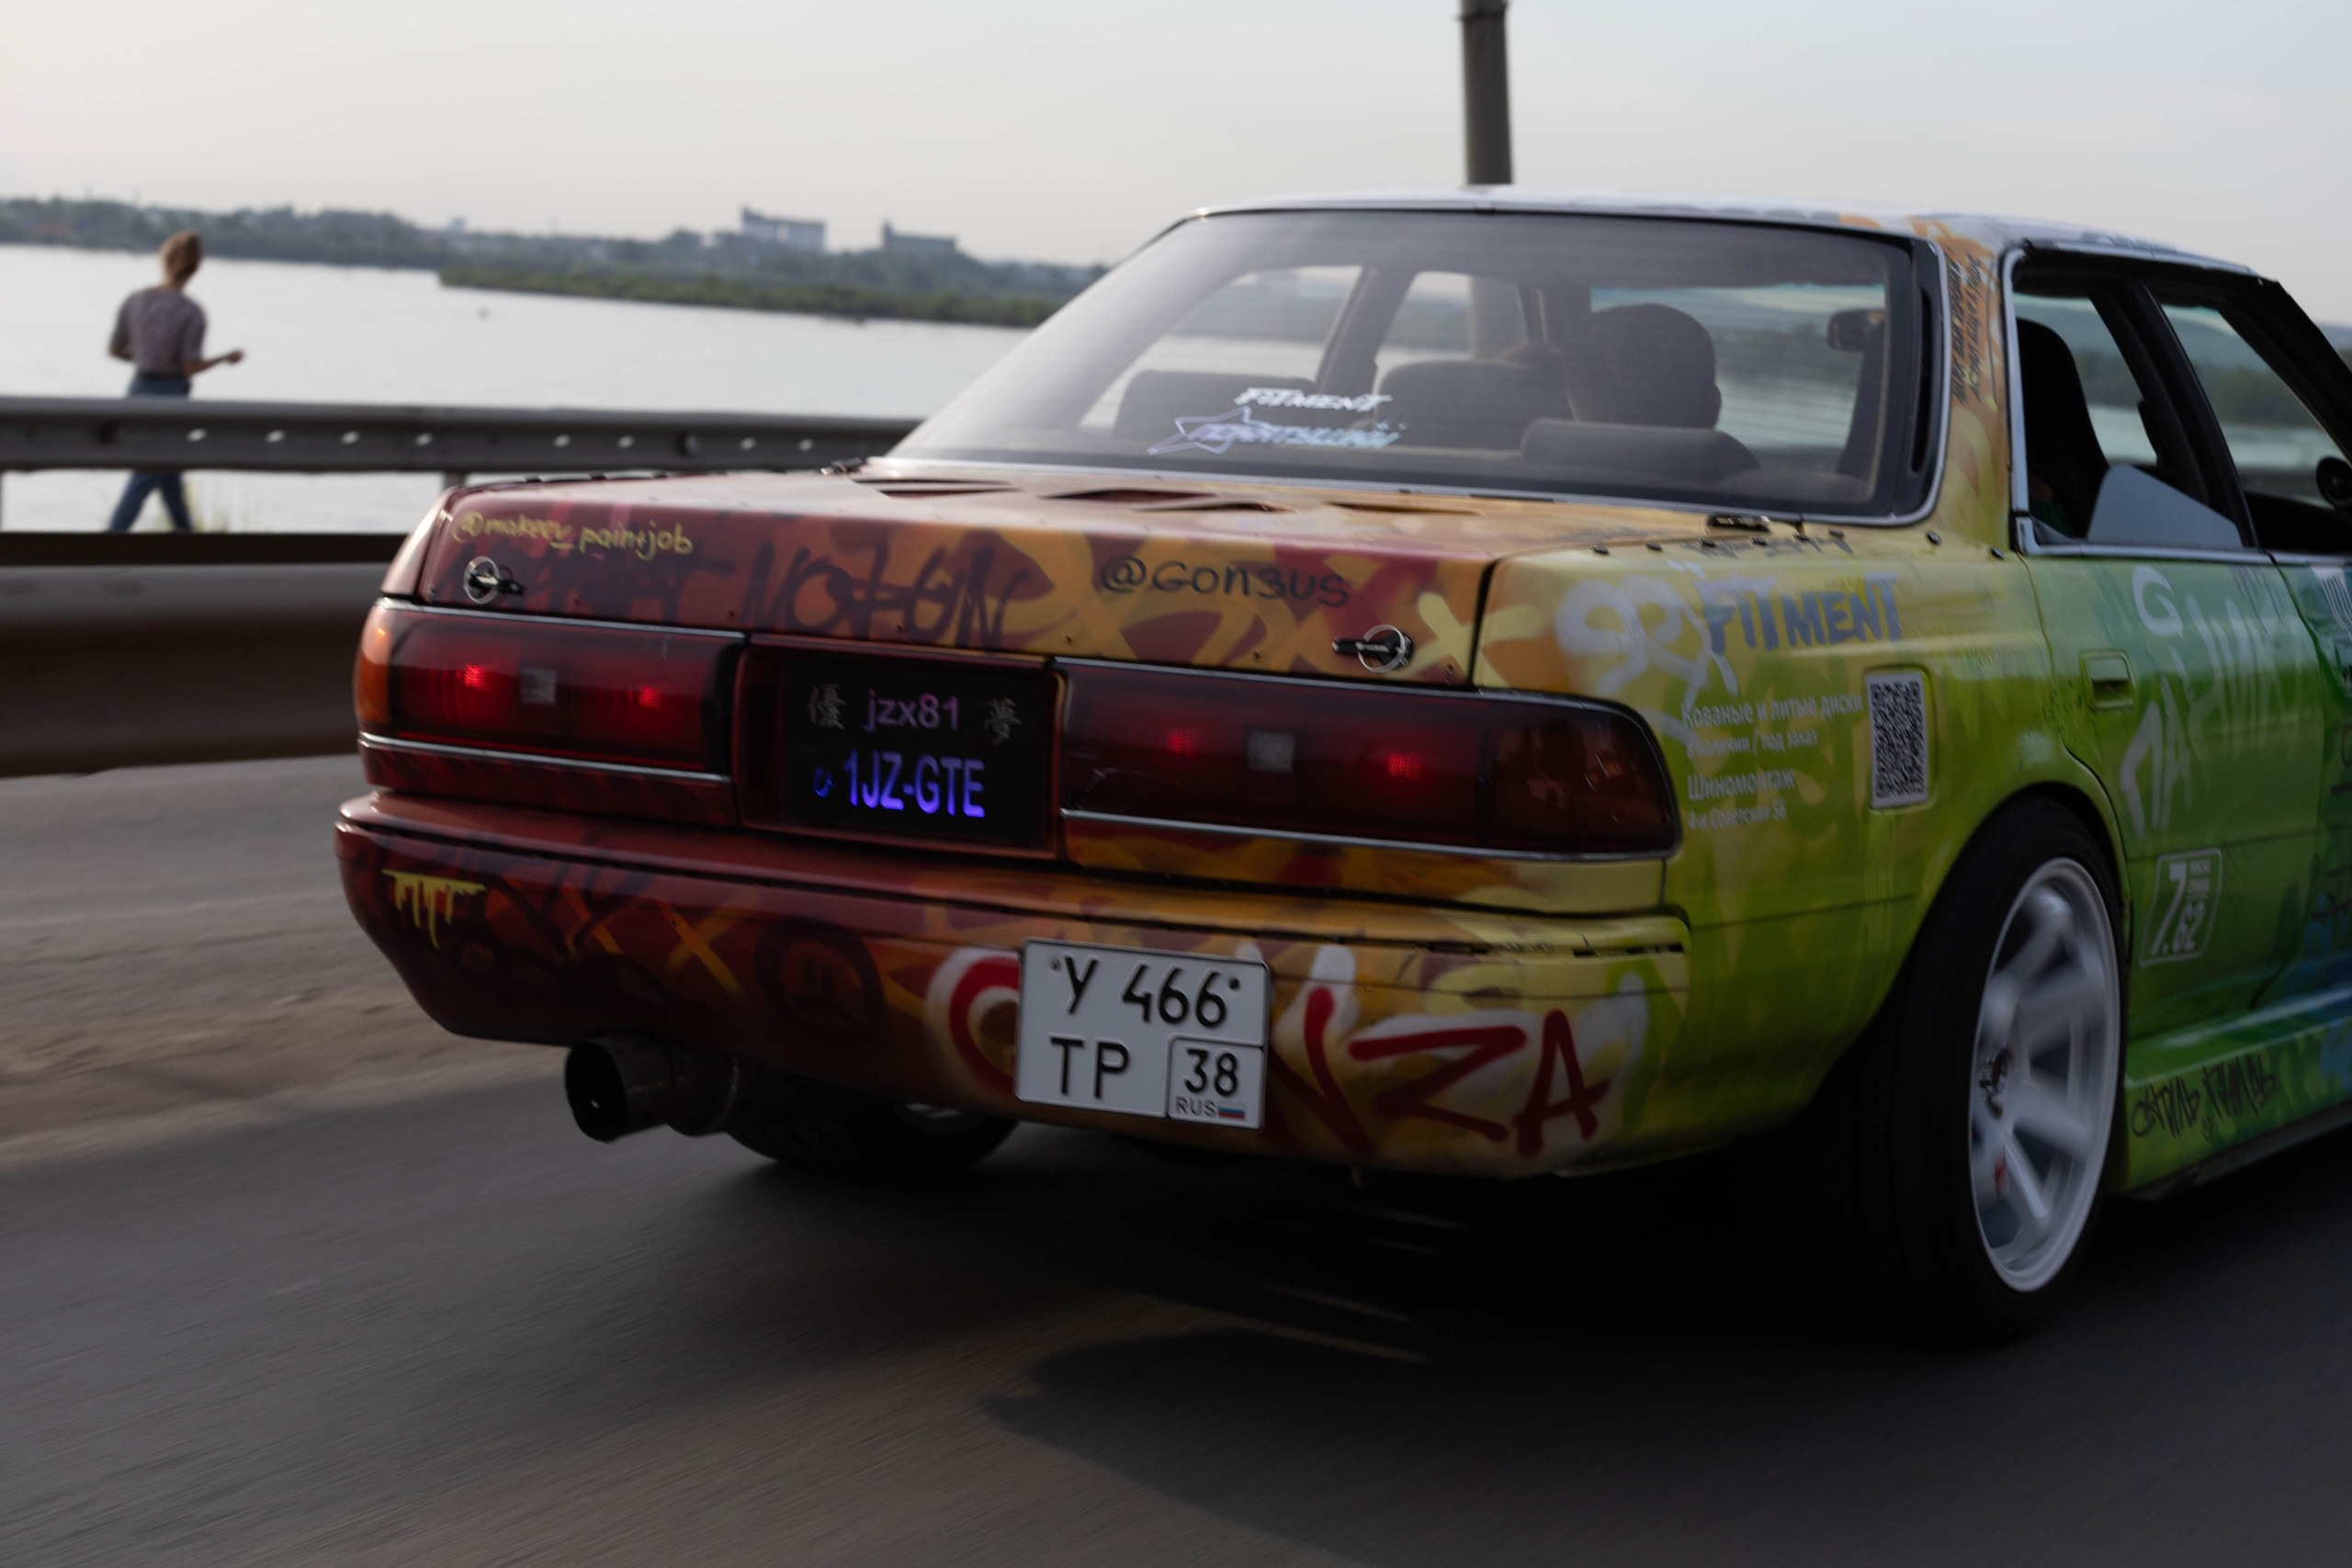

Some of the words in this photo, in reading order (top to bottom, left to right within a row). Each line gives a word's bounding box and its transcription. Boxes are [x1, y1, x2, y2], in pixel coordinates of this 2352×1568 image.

[1691, 570, 1904, 654] FITMENT
[863, 689, 959, 732] jzx81
[1680, 703, 1754, 729] Кованые
[1756, 701, 1769, 721] и
[1770, 697, 1818, 721] литые
[1821, 694, 1864, 721] диски
[842, 748, 986, 818] 1JZ-GTE
[1688, 768, 1796, 802] Шиномонтаж
[1121, 961, 1227, 1029] 466
[1184, 1044, 1238, 1097] 38
[1175, 1095, 1216, 1118] RUS
